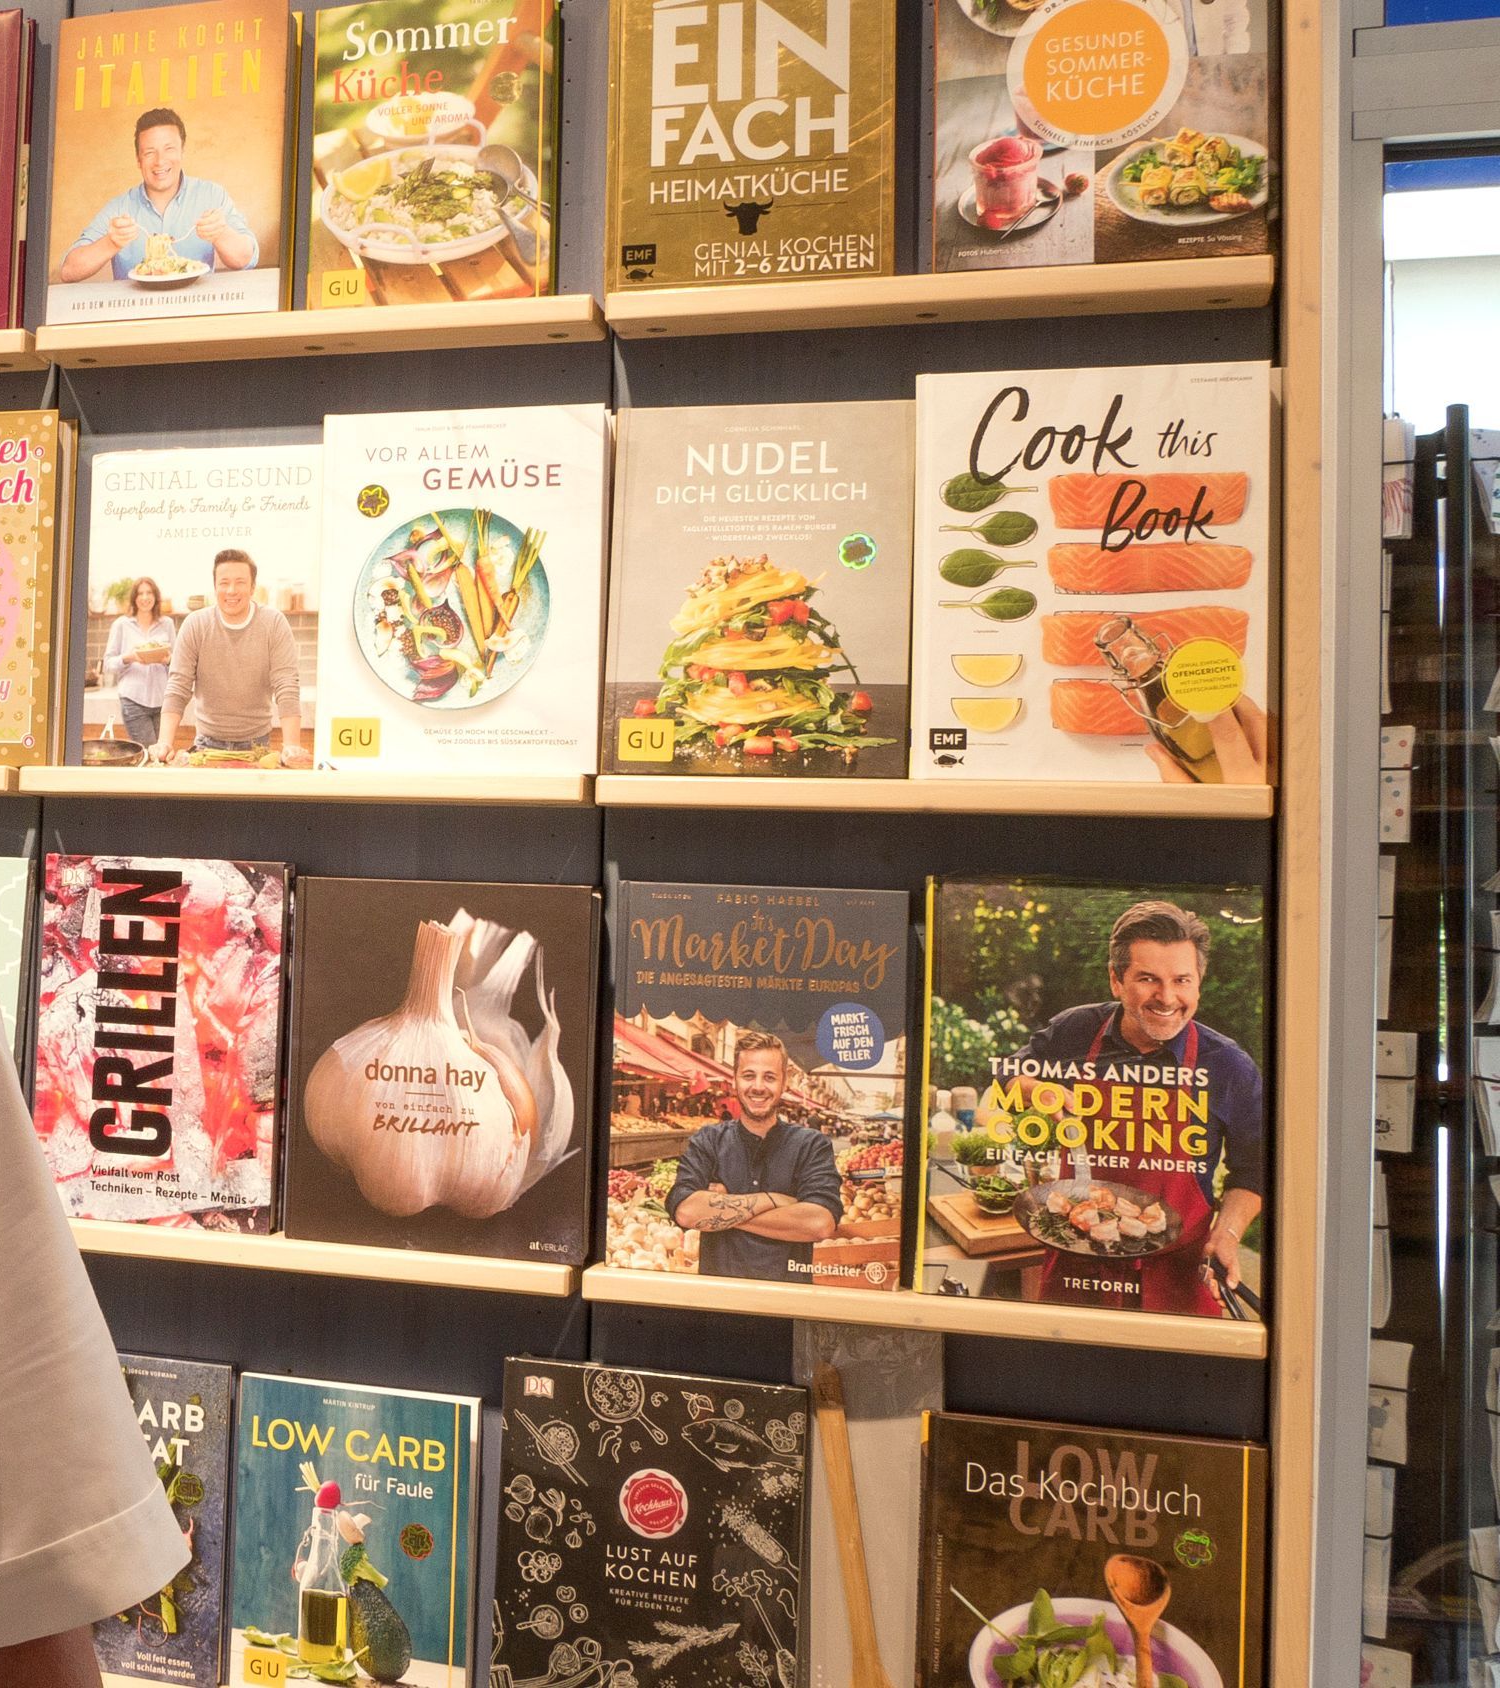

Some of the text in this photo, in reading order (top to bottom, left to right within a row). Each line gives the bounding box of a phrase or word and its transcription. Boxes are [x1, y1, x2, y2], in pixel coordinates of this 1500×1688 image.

[77, 18, 263, 60] JAMIE KOCHT
[342, 16, 517, 61] Sommer
[1046, 31, 1145, 53] GESUNDE
[652, 1, 850, 107] EIN
[1047, 51, 1152, 75] SOMMER-
[74, 48, 261, 112] ITALIEN
[332, 61, 444, 104] Küche
[1047, 73, 1146, 102] KÜCHE
[377, 102, 448, 117] VOLLER SONNE
[411, 113, 470, 126] UND AROMA
[651, 94, 849, 167] FACH
[650, 167, 849, 204] HEIMATKÜCHE
[626, 250, 653, 261] EMF
[694, 233, 875, 261] GENIAL KOCHEN
[695, 261, 729, 278] MIT
[777, 252, 875, 273] ZUTATEN
[969, 386, 1218, 485] Cook this
[366, 444, 490, 462] VOR ALLEM
[686, 441, 839, 477] NUDEL
[104, 467, 313, 492] GENIAL GESUND
[423, 458, 562, 491] GEMÜSE
[656, 480, 868, 505] DICH GLÜCKLICH
[103, 501, 166, 520] Superfood
[168, 500, 187, 520] for
[189, 497, 238, 518] Family
[260, 496, 311, 512] Friends
[1101, 479, 1218, 553] Book
[156, 527, 252, 539] JAMIE OLIVER
[933, 733, 964, 746] EMF
[631, 913, 899, 990] Market Day
[636, 971, 860, 993] DIE ANGESAGTESTEN MÄRKTE EUROPAS
[89, 868, 183, 1157] GRILLEN
[830, 1012, 869, 1025] MARKT-
[833, 1036, 874, 1049] AUF DEN
[834, 1025, 869, 1037] FRISCH
[837, 1048, 871, 1062] TELLER
[365, 1059, 486, 1093] donna hay
[988, 1057, 1209, 1086] THOMAS ANDERS
[375, 1102, 475, 1115] von einfach zu
[989, 1079, 1208, 1124] MODERN
[373, 1114, 480, 1136] BRILLANT
[987, 1115, 1208, 1156] COOKING
[90, 1164, 180, 1183] Vielfalt vom Rost
[1067, 1152, 1129, 1168] LECKER
[1138, 1158, 1207, 1174] ANDERS
[90, 1180, 247, 1205] Techniken Rezepte Menüs
[787, 1258, 861, 1278] Brandstätter
[1063, 1277, 1140, 1294] TRETORRI
[132, 1399, 205, 1433] ARB
[322, 1398, 376, 1411] MARTIN KINTRUP
[252, 1415, 446, 1472] LOW CARB
[1016, 1440, 1158, 1498] LOW
[355, 1474, 434, 1500] für Faule
[965, 1461, 1201, 1517] Das Kochbuch
[1009, 1492, 1158, 1548] CARB
[606, 1545, 698, 1566] LUST AUF
[605, 1563, 697, 1589] KOCHEN
[609, 1588, 690, 1605] KREATIVE REZEPTE
[615, 1597, 683, 1613] FÜR JEDEN TAG
[121, 1660, 196, 1680] voll schlank werden
[136, 1650, 193, 1669] Voll fett essen,
